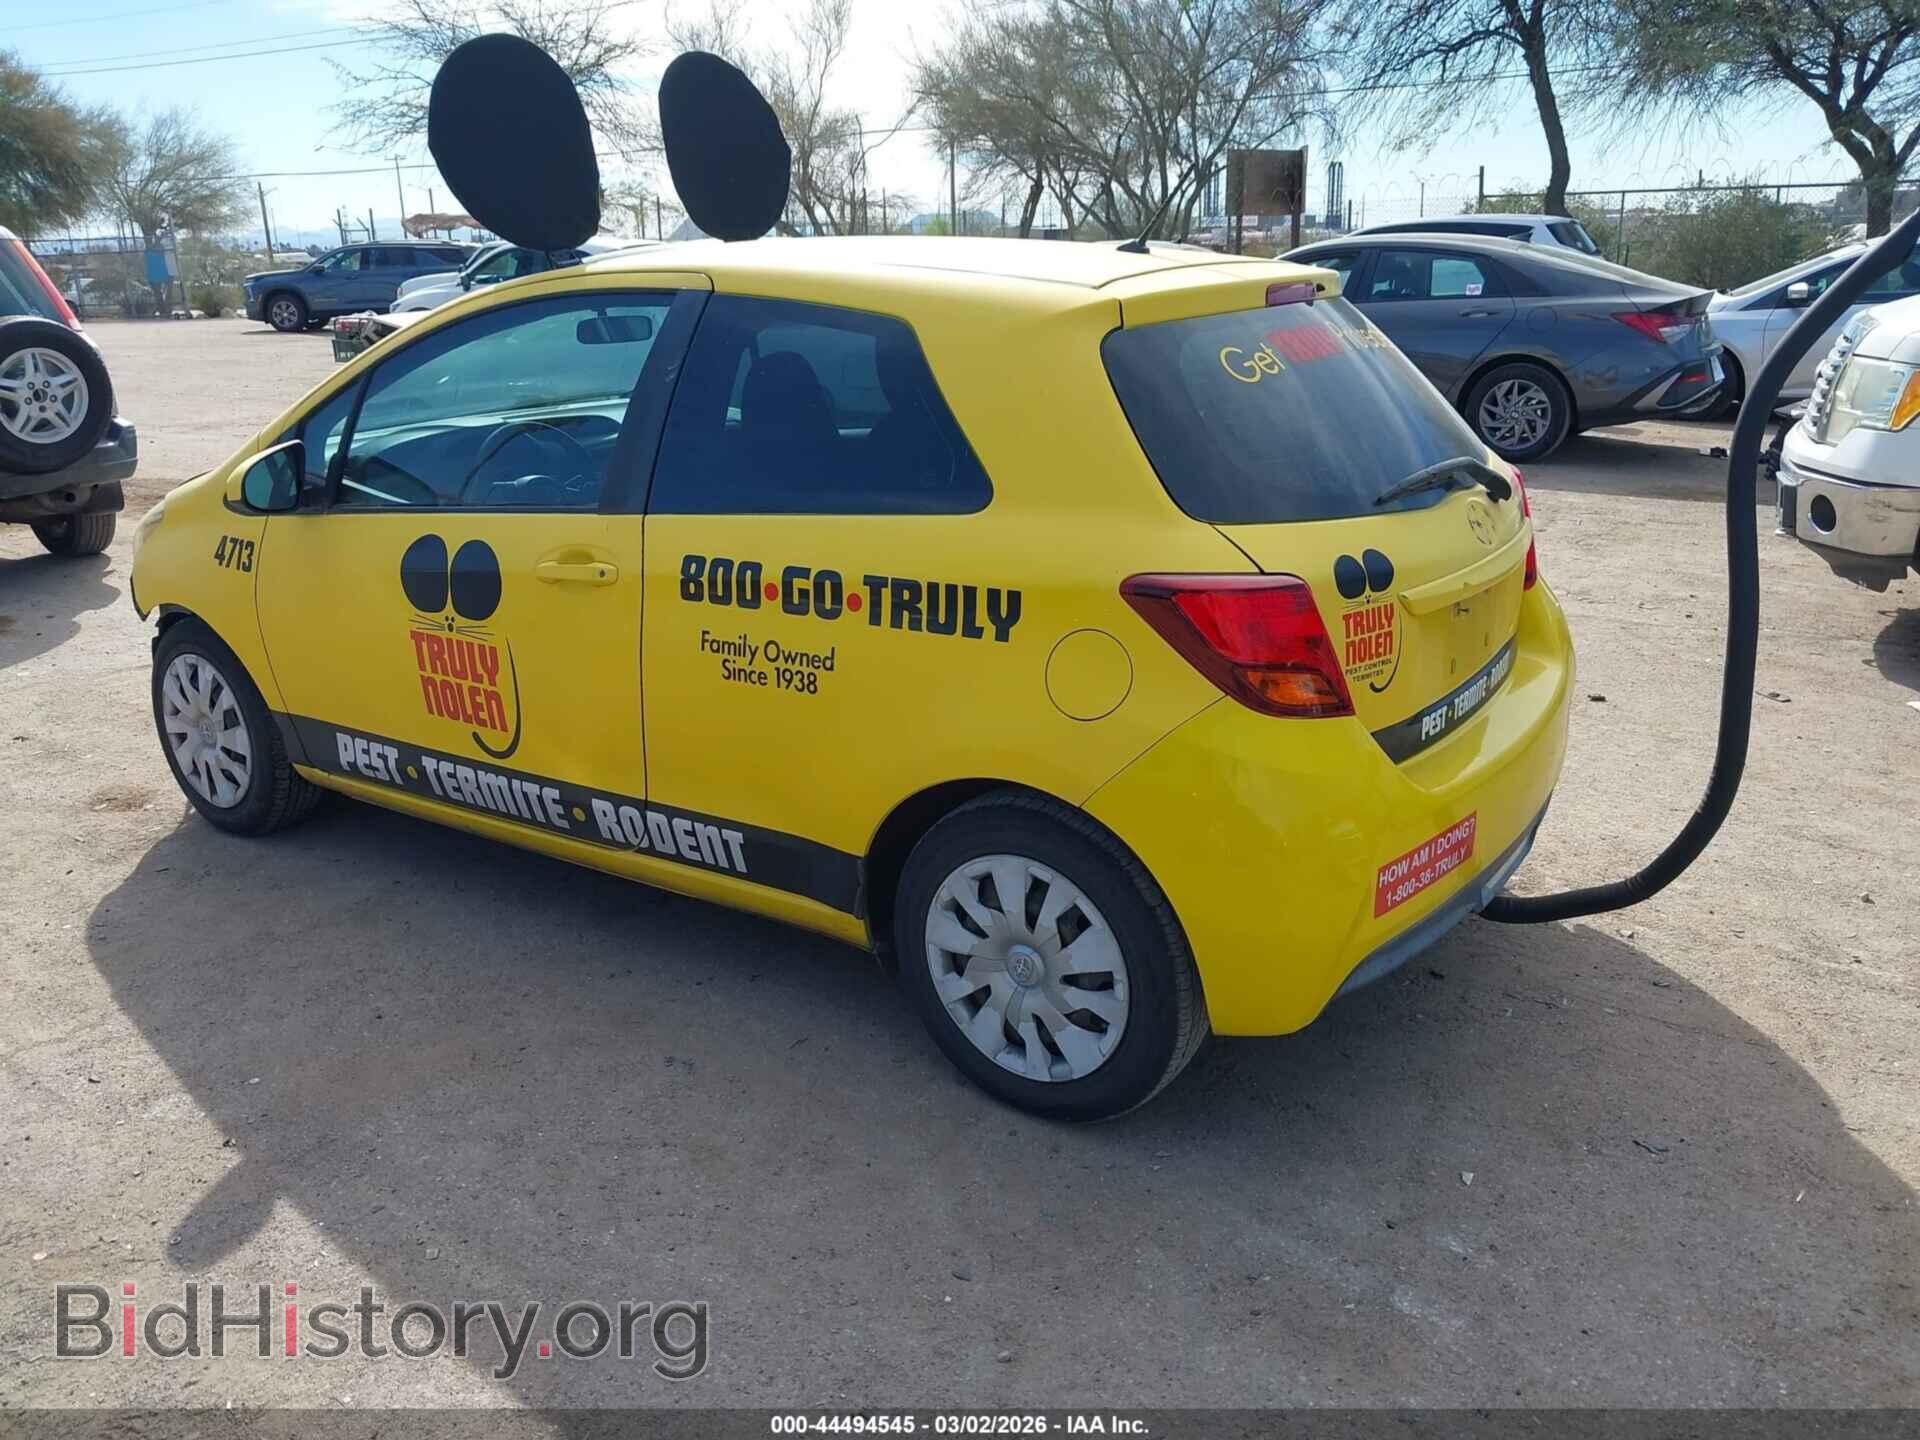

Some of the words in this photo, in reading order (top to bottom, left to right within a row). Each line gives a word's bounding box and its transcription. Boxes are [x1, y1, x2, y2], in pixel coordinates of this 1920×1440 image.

[1220, 342, 1286, 383] Get
[214, 535, 255, 573] 4713
[680, 554, 763, 610] 800
[782, 565, 844, 620] GO
[863, 574, 1022, 643] TRULY
[1343, 603, 1394, 639] TRULY
[410, 630, 499, 687] TRULY
[701, 630, 759, 665] Family
[764, 640, 836, 672] Owned
[1345, 631, 1393, 667] NOLEN
[722, 659, 768, 686] Since
[774, 667, 818, 694] 1938
[420, 675, 509, 732] NOLEN
[1422, 705, 1448, 741] PEST
[1454, 676, 1487, 720] TERMITE
[336, 732, 404, 785] PEST
[421, 755, 570, 829] TERMITE
[591, 798, 749, 873] RODENT
[1378, 857, 1411, 888] HOW
[1411, 845, 1430, 871] AM
[1437, 818, 1476, 854] DOING?
